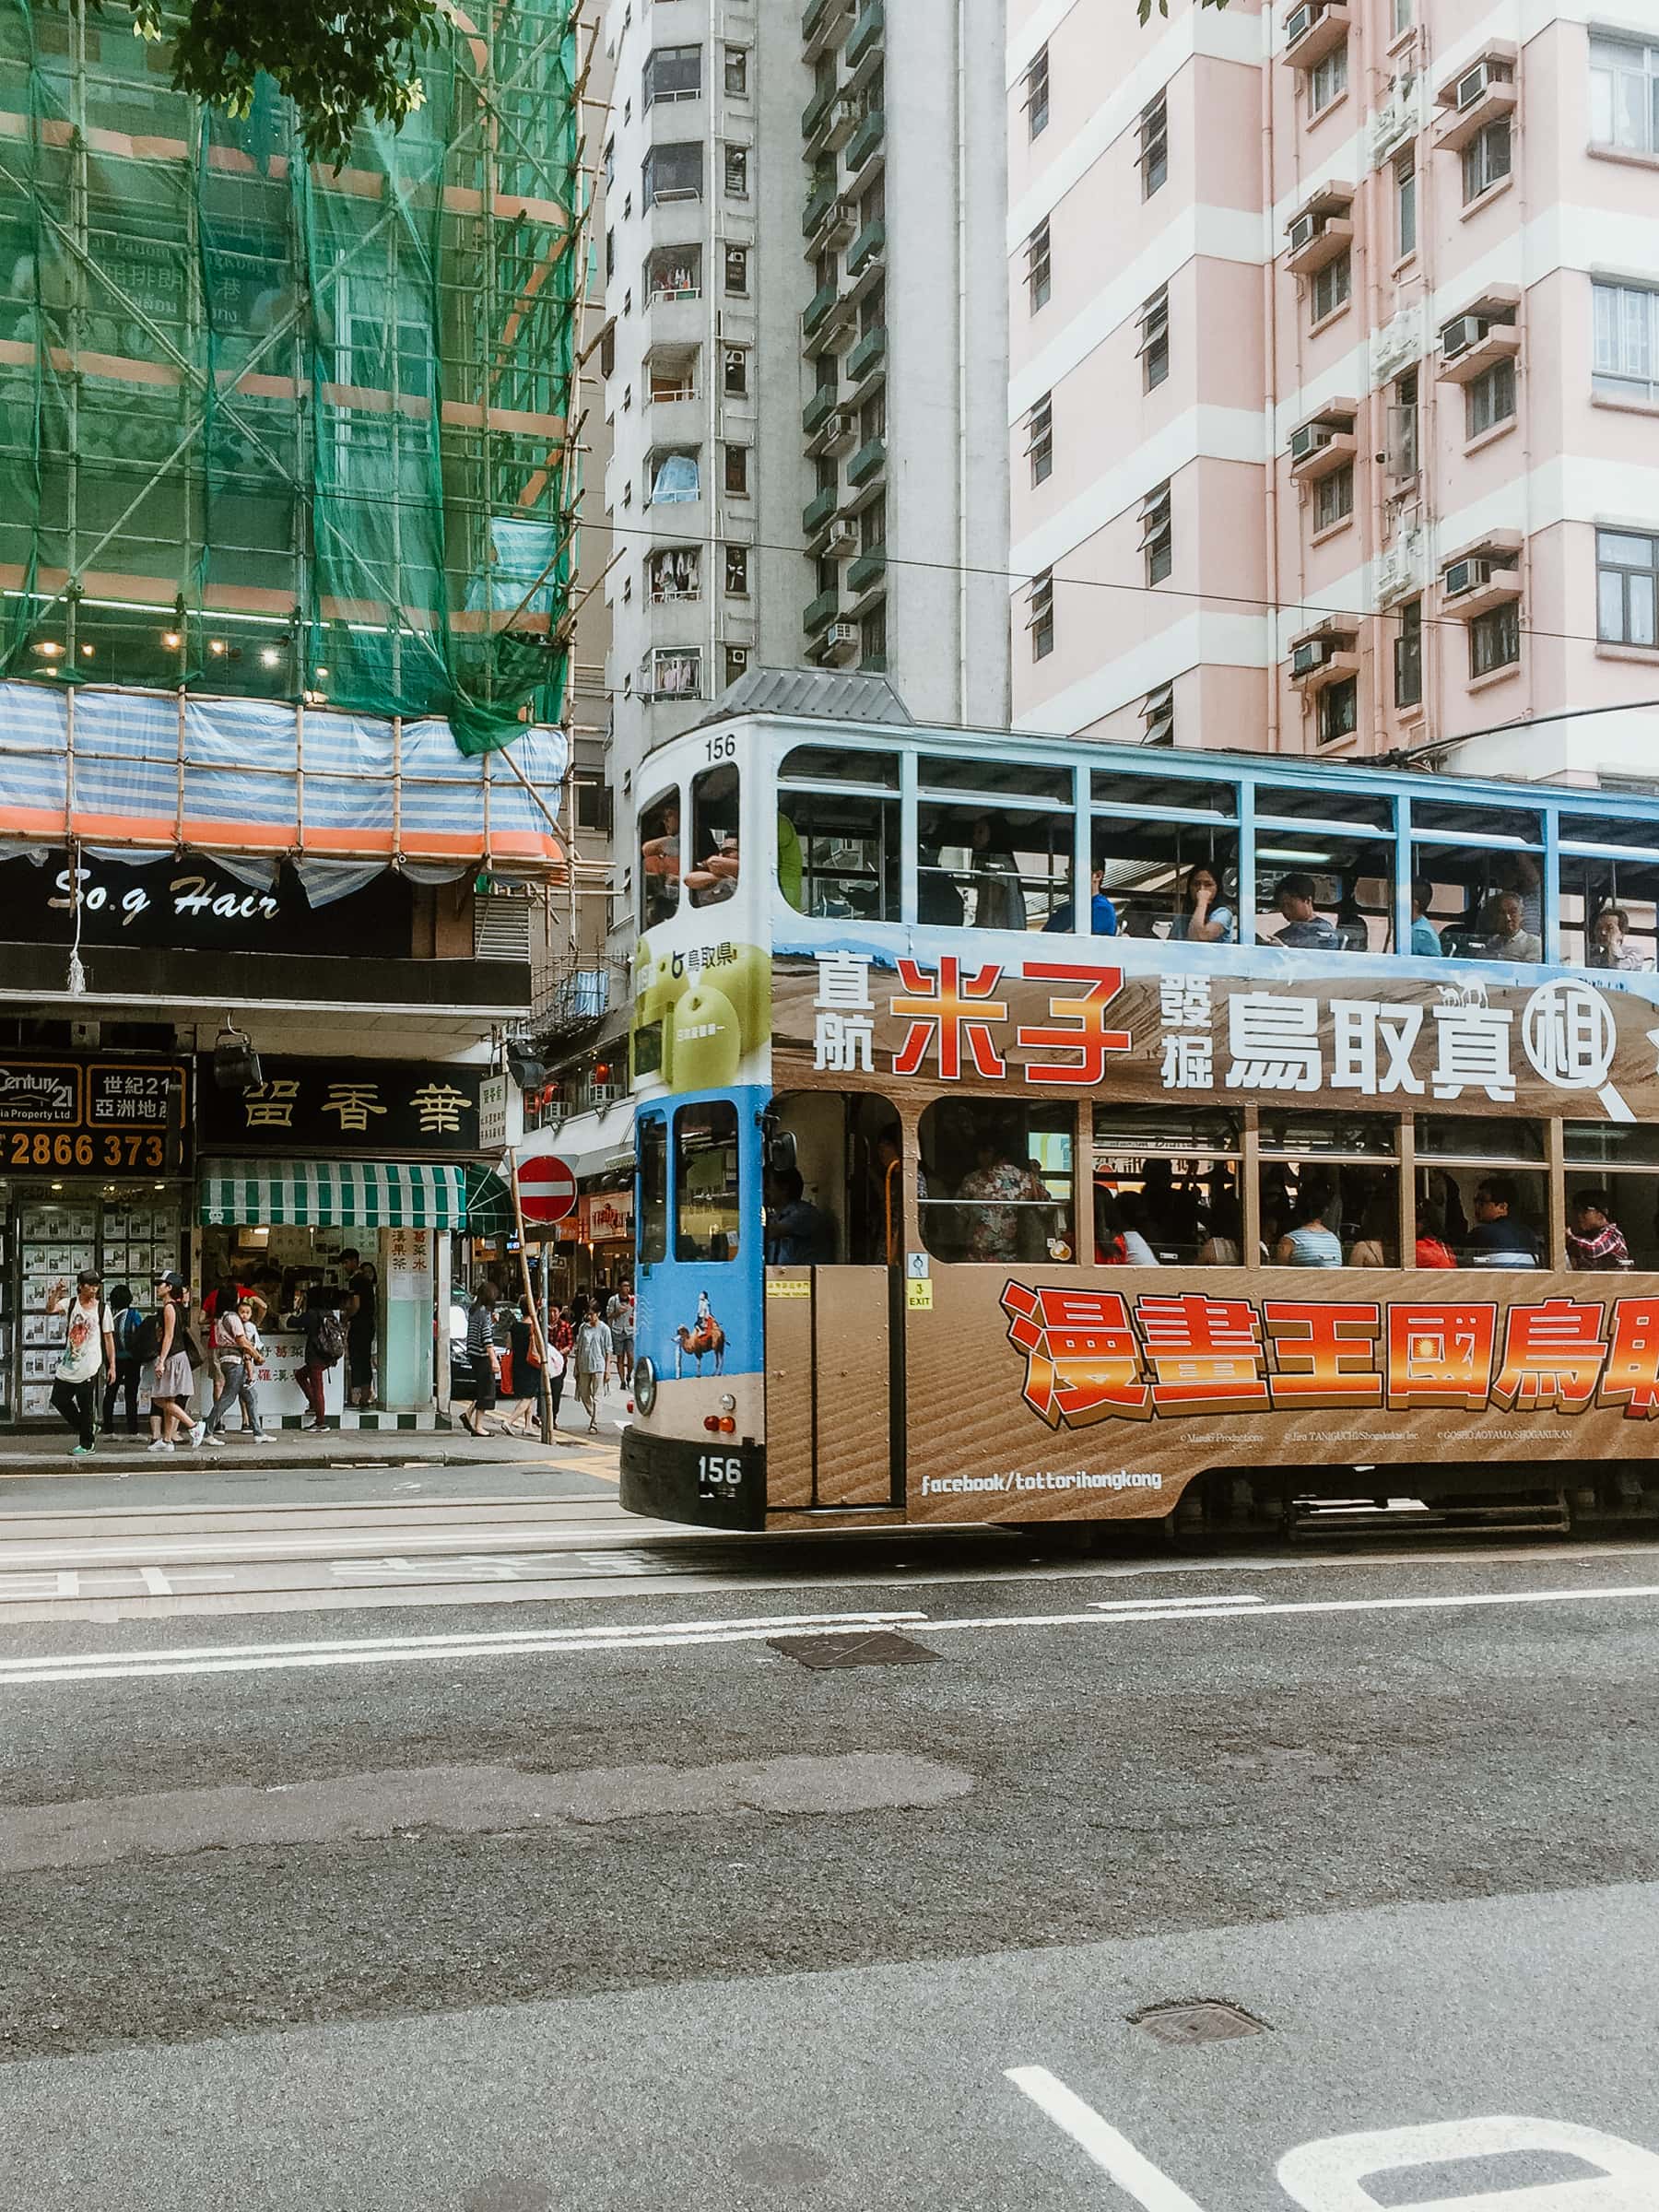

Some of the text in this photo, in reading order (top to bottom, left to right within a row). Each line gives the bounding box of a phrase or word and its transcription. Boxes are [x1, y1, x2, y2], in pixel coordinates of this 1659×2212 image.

[705, 734, 735, 762] 156
[170, 877, 281, 920] Hair
[813, 950, 1617, 1102] 直航 米子 發掘 鳥取真相
[53, 1086, 73, 1107] 21
[103, 1076, 171, 1095] 世紀21
[11, 1109, 53, 1121] Property
[11, 1133, 93, 1166] 2866
[103, 1135, 183, 1167] 373
[909, 1297, 930, 1306] EXIT
[699, 1455, 742, 1484] 156
